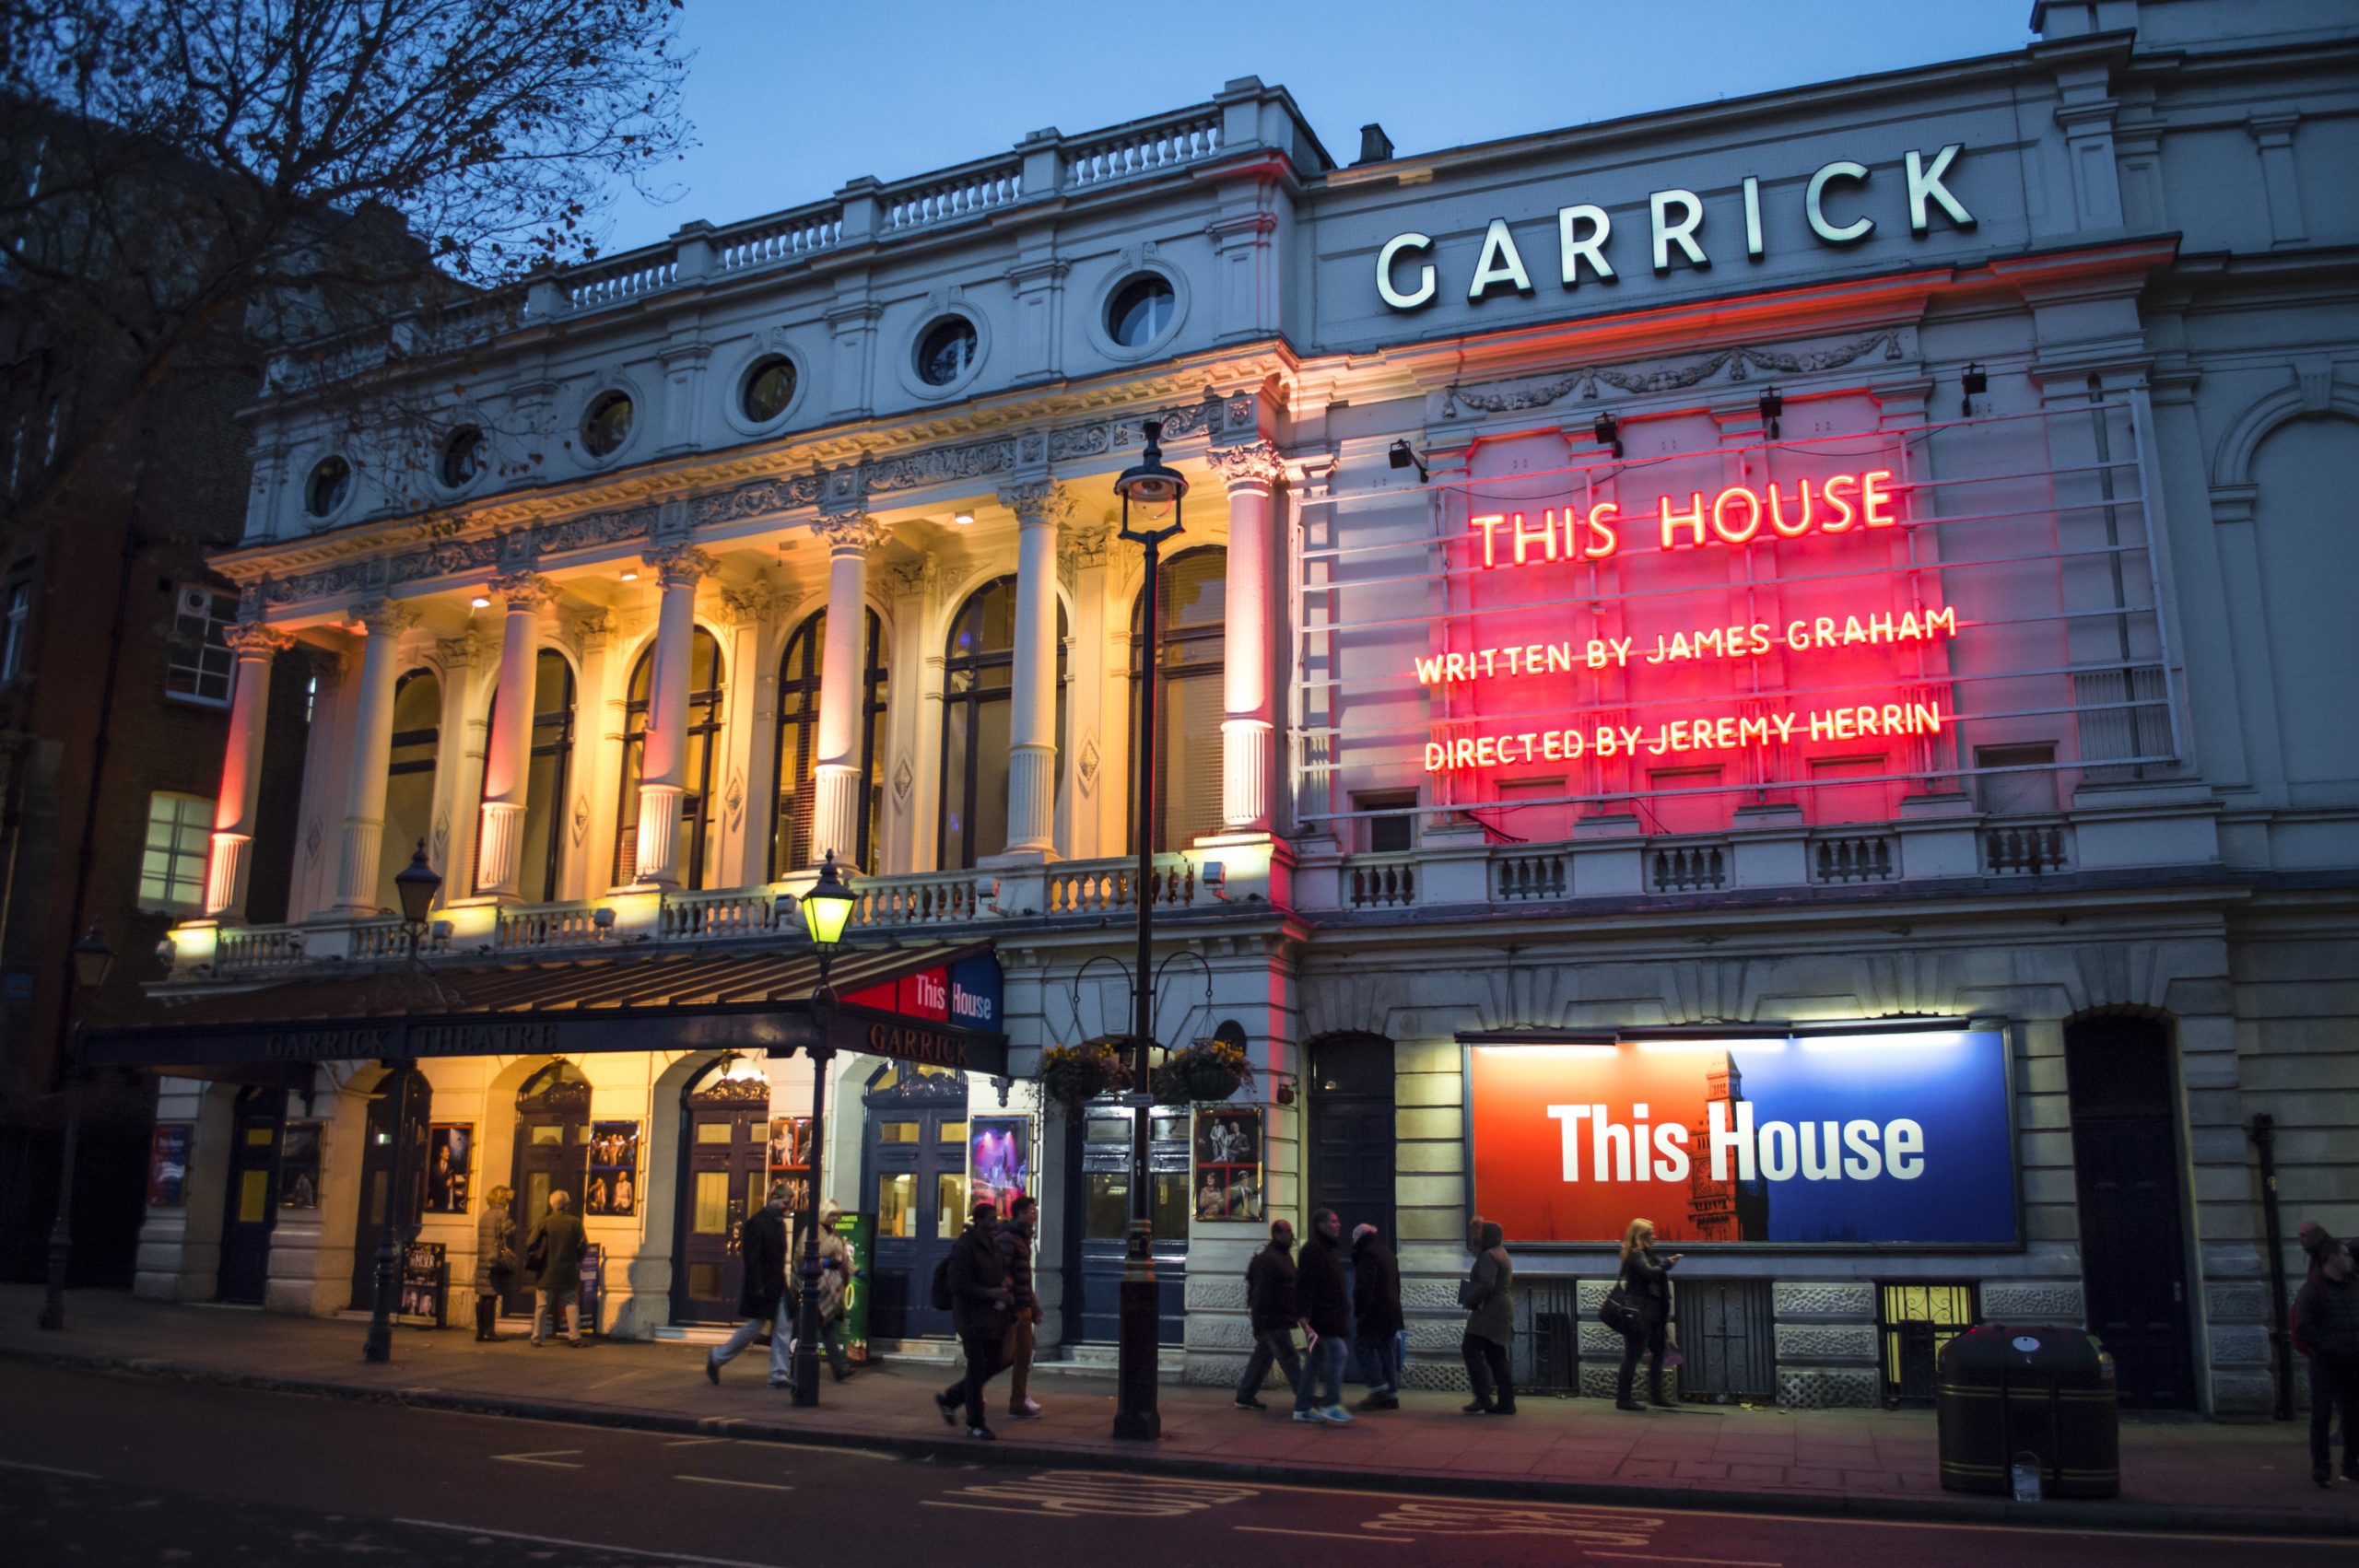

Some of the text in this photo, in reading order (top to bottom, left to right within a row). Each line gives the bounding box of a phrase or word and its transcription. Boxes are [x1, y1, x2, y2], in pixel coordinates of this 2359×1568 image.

[1374, 142, 1978, 314] GARRICK
[1471, 469, 1897, 569] THIS HOUSE
[1414, 605, 1958, 686] WRITTEN BY JAMES GRAHAM
[1424, 700, 1941, 772] DIRECTED BY JEREMY HERRIN
[916, 973, 992, 1021] This House
[267, 1023, 558, 1057] GARRICK THEATRE
[869, 1023, 968, 1064] GARRICK
[1547, 1101, 1925, 1183] This House
